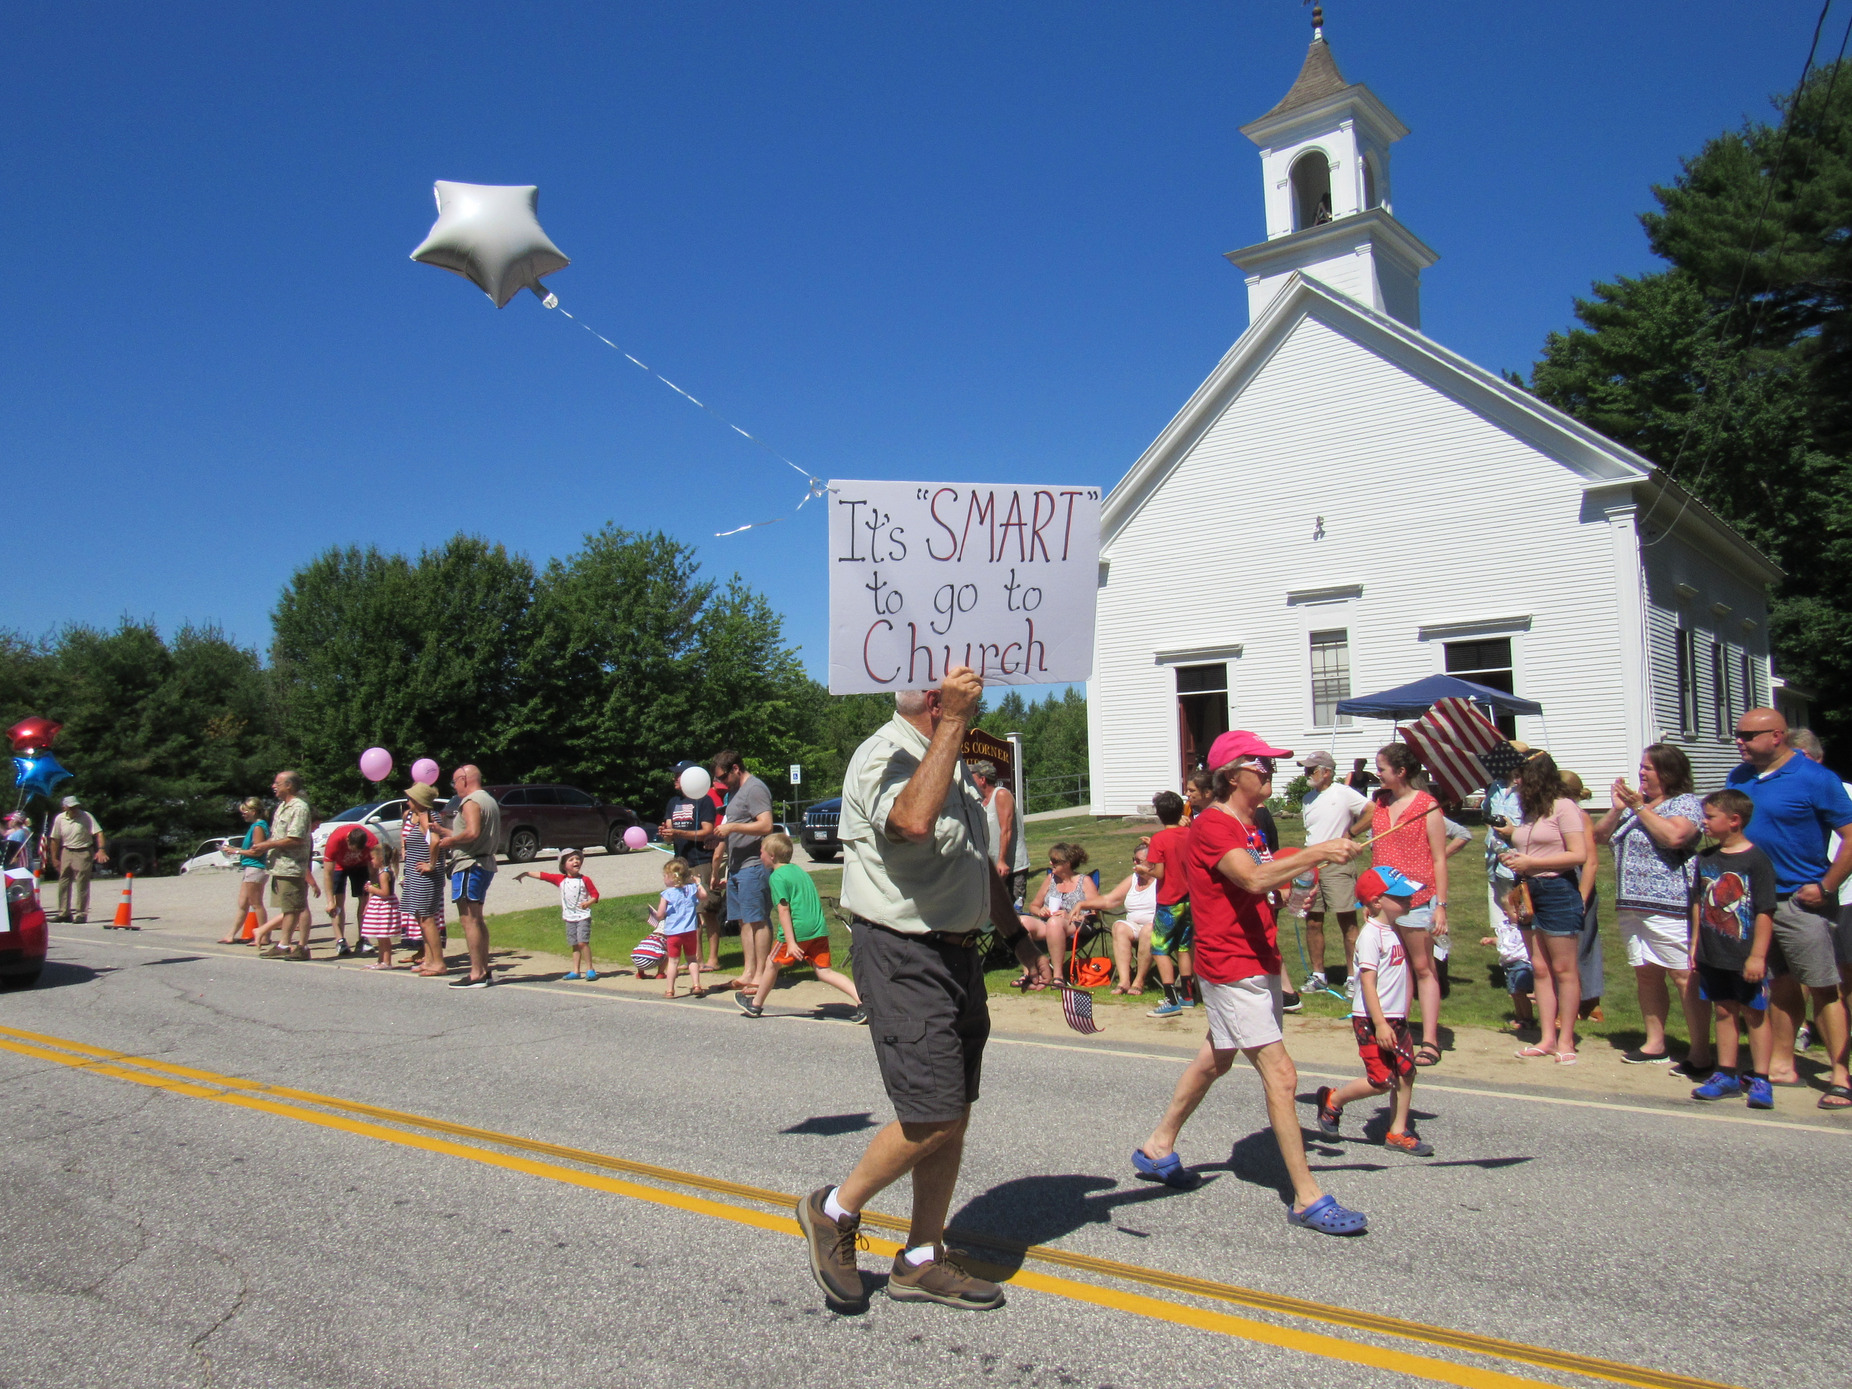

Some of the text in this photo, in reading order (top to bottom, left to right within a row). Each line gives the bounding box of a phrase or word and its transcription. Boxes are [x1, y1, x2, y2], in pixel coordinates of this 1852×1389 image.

[838, 487, 1099, 564] It's "SMART"
[865, 568, 1043, 635] to go to
[863, 617, 1048, 684] Church
[972, 741, 1010, 764] CORNER
